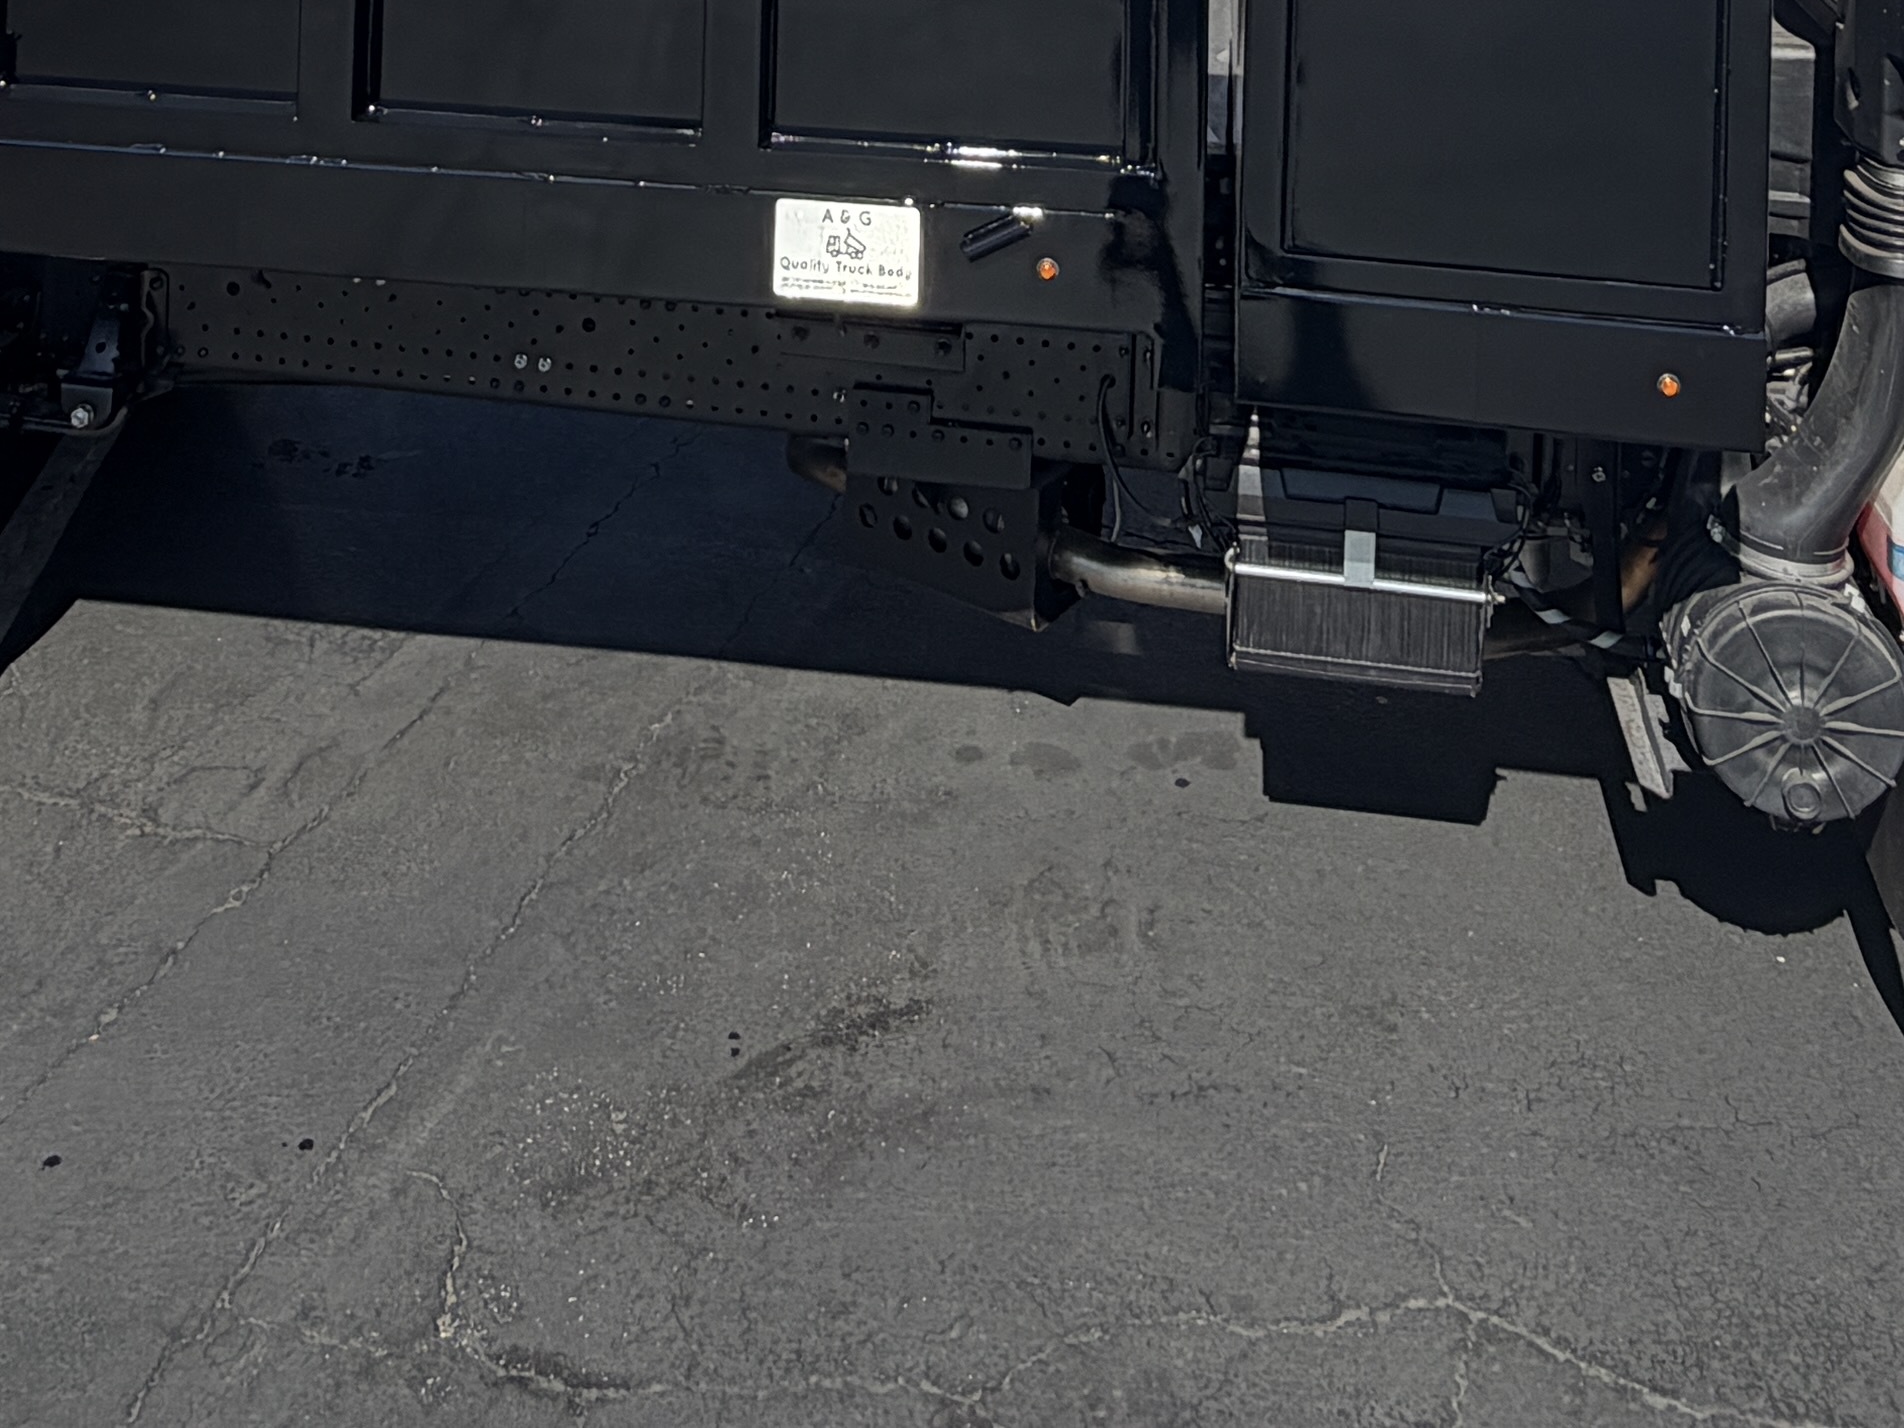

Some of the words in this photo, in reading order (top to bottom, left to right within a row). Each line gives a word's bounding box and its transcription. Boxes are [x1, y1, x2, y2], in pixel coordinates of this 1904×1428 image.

[821, 208, 834, 224] A
[859, 210, 872, 226] G
[780, 256, 829, 274] Quality
[835, 260, 873, 276] Truck
